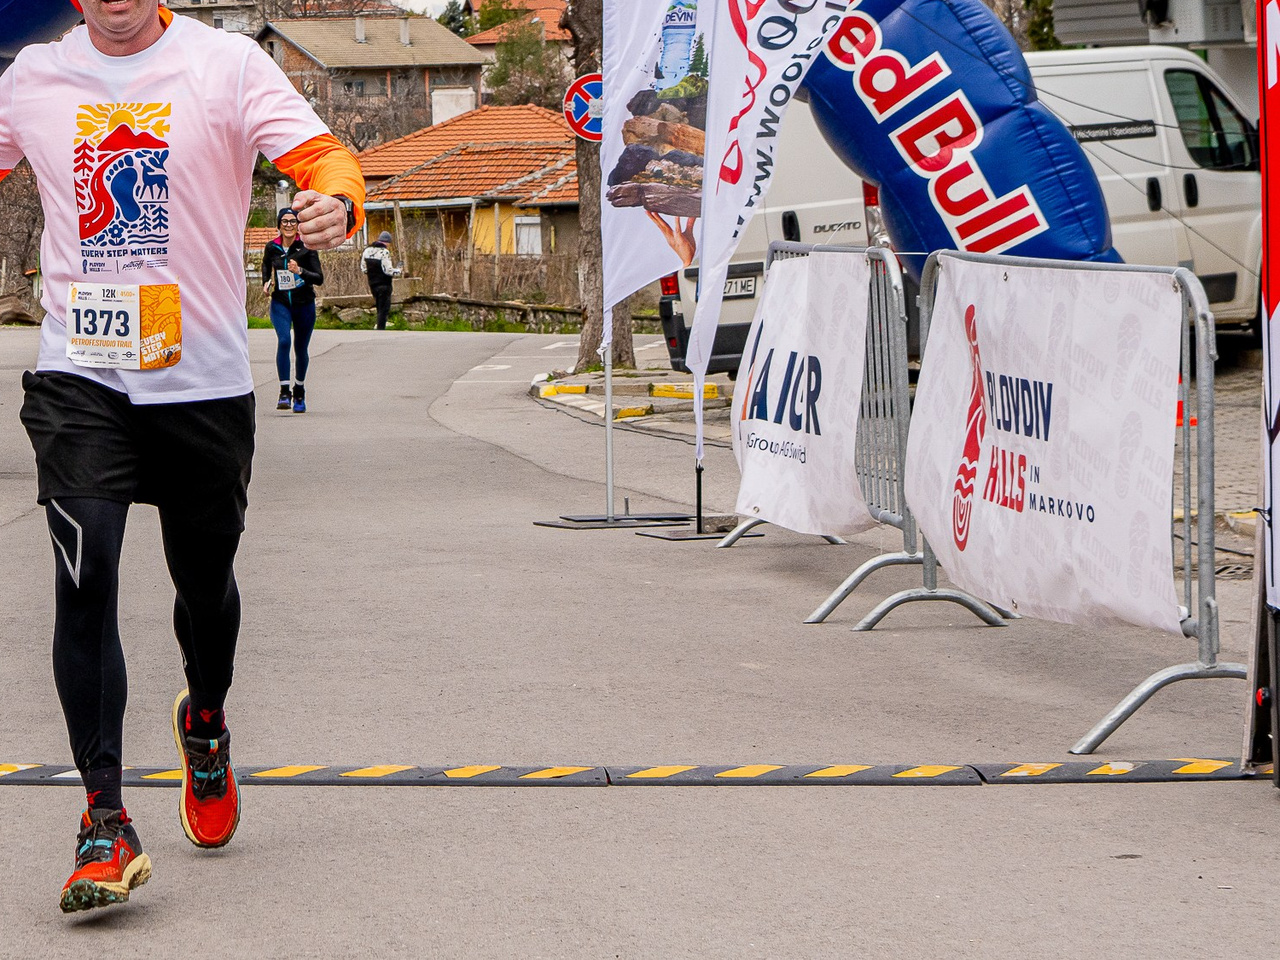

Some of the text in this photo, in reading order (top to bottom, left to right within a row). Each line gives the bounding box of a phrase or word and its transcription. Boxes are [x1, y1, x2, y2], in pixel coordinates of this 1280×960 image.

[665, 10, 694, 25] DEVIN
[896, 97, 1041, 253] Bull
[813, 221, 862, 233] DUCATO
[81, 247, 168, 257] EVERY STEP MATTERS
[101, 288, 116, 299] 12K
[72, 308, 130, 337] 1373
[117, 340, 133, 348] TRAIL
[985, 370, 1053, 442] PLOVDIV
[982, 444, 1040, 514] HILLS IN
[1029, 492, 1095, 523] MARKOVO
